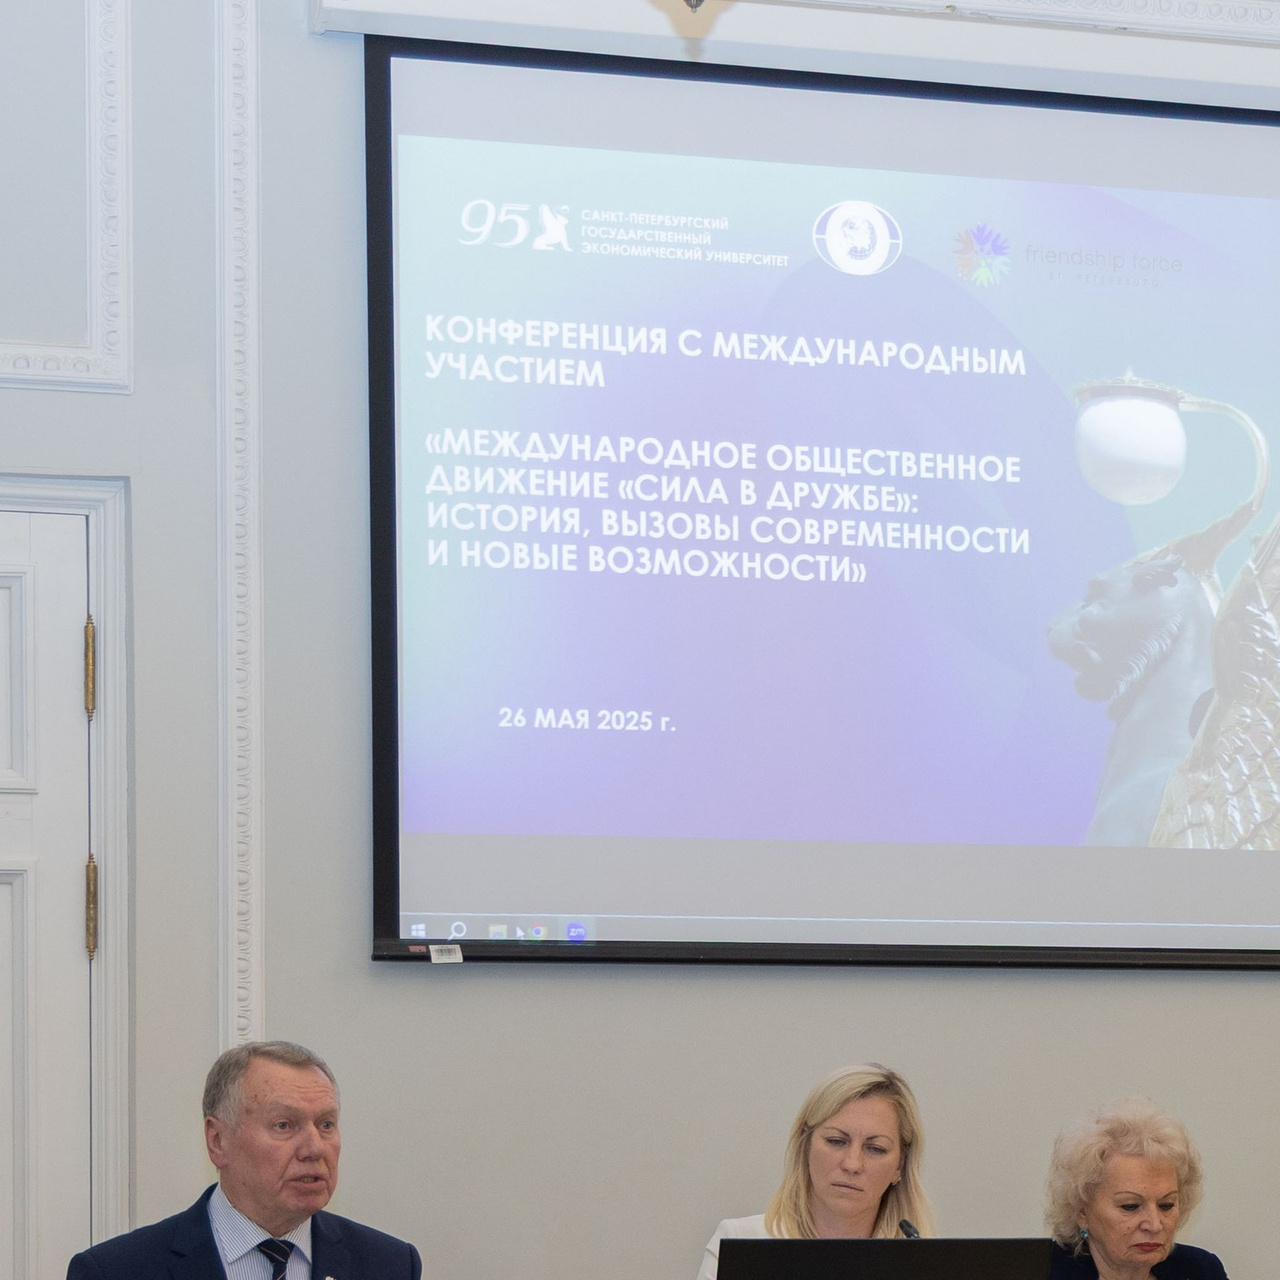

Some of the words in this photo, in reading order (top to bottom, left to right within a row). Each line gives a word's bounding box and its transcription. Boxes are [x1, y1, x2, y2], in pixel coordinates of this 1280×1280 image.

[458, 199, 530, 248] 95
[581, 209, 729, 231] САНКТ-ПЕТЕРБУРГСКИЙ
[581, 226, 711, 246] ГОСУДАРСТВЕННЫЙ
[581, 242, 702, 261] ЭКОНОМИЧЕСКИЙ
[705, 252, 789, 268] УНИВЕРСИТЕТ
[1024, 244, 1126, 272] friendship
[1132, 249, 1183, 272] force
[425, 314, 667, 355] КОНФЕРЕНЦИЯ
[678, 330, 703, 357] С
[712, 332, 1026, 376] МЕЖДУНАРОДНЫМ
[425, 352, 605, 388] УЧАСТИЕМ
[425, 428, 757, 469] «МЕЖДУНАРОДНОЕ
[766, 444, 1021, 483] ОБЩЕСТВЕННОЕ
[426, 465, 609, 499] ДВИЖЕНИЕ
[618, 475, 729, 505] «СИЛА
[740, 480, 758, 506] В
[766, 482, 919, 514] ДРУЖБЕ»:
[427, 502, 590, 539] ИСТОРИЯ,
[602, 510, 740, 542] ВЫЗОВЫ
[750, 515, 1030, 555] СОВРЕМЕННОСТИ
[427, 540, 449, 566] И
[461, 542, 577, 571] НОВЫЕ
[589, 546, 867, 584] ВОЗМОЖНОСТИ»
[498, 707, 527, 728] 26
[534, 708, 590, 729] МАЯ
[597, 710, 653, 732] 2025
[660, 716, 677, 732] г.
